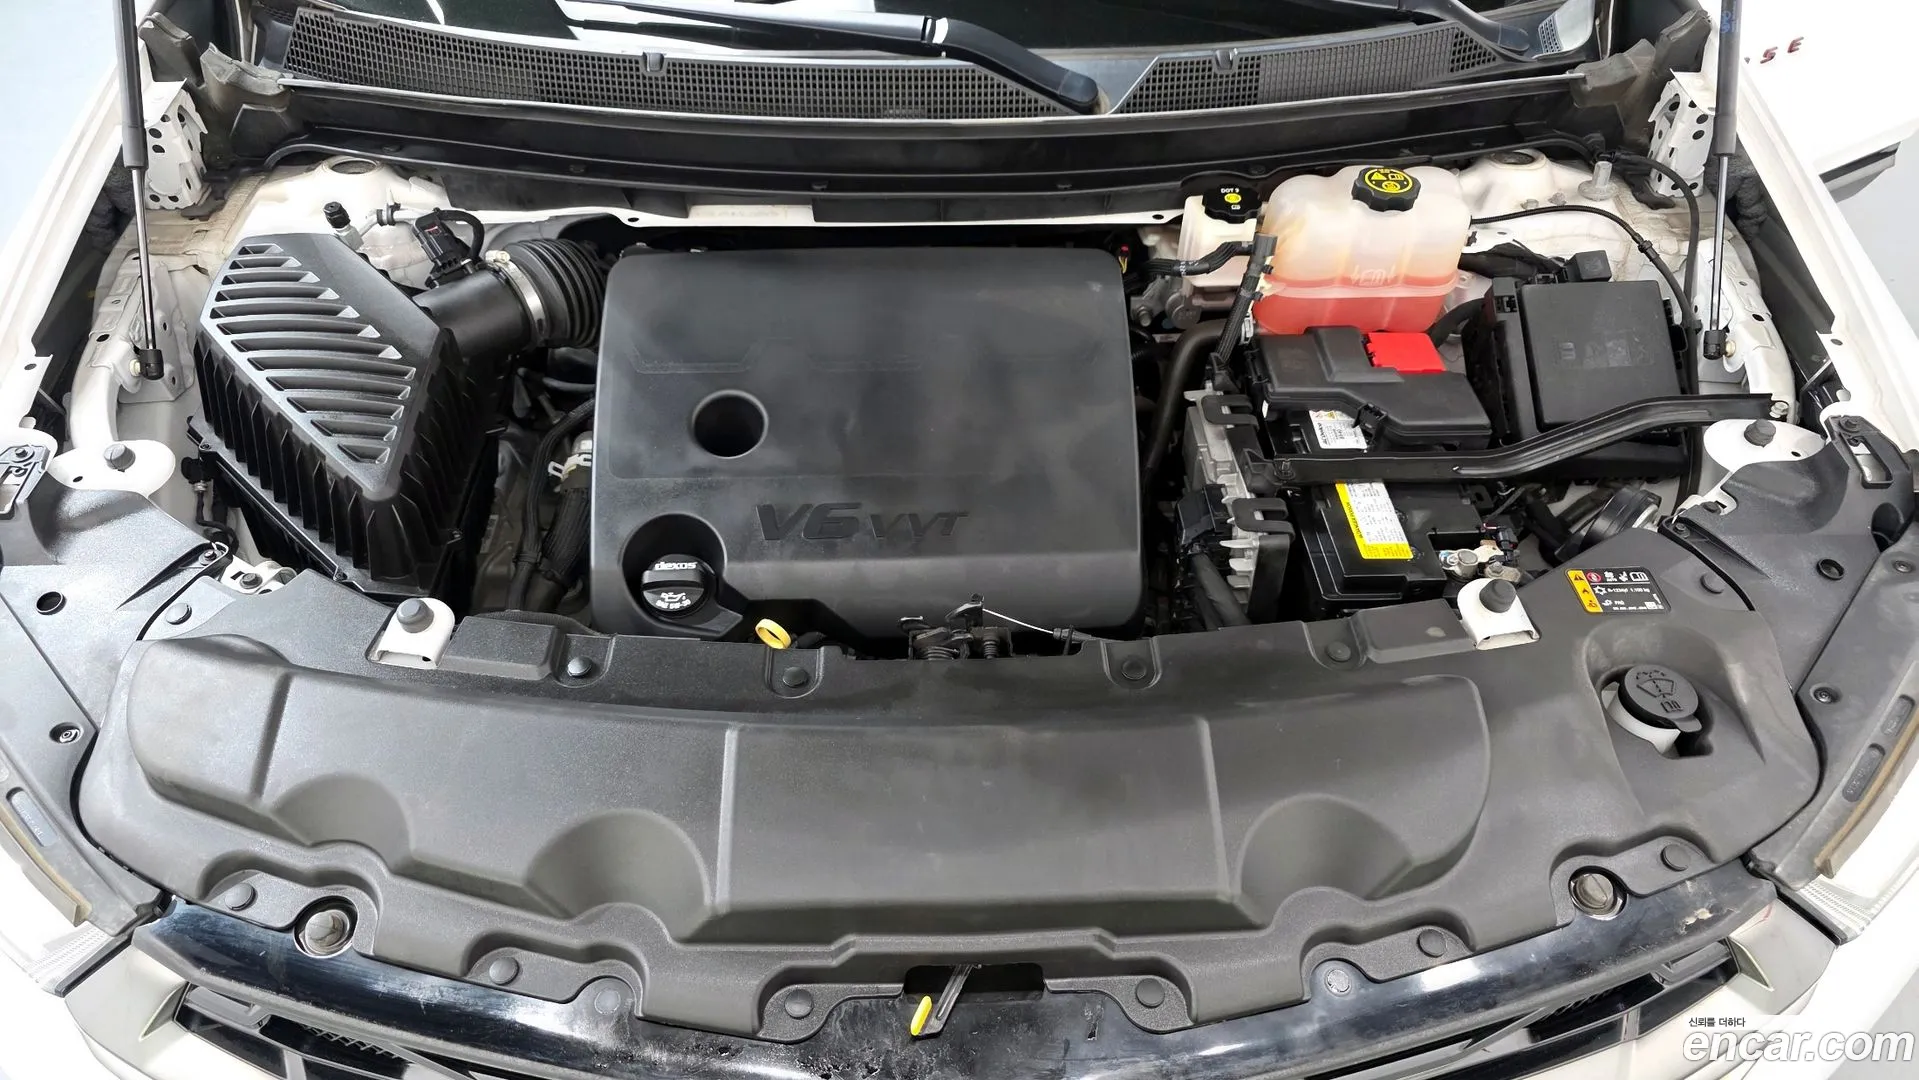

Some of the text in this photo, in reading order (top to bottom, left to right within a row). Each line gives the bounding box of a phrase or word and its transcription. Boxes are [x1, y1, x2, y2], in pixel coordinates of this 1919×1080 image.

[1744, 36, 1805, 64] SE
[755, 502, 972, 541] V6 VVT
[654, 561, 698, 571] dexos
